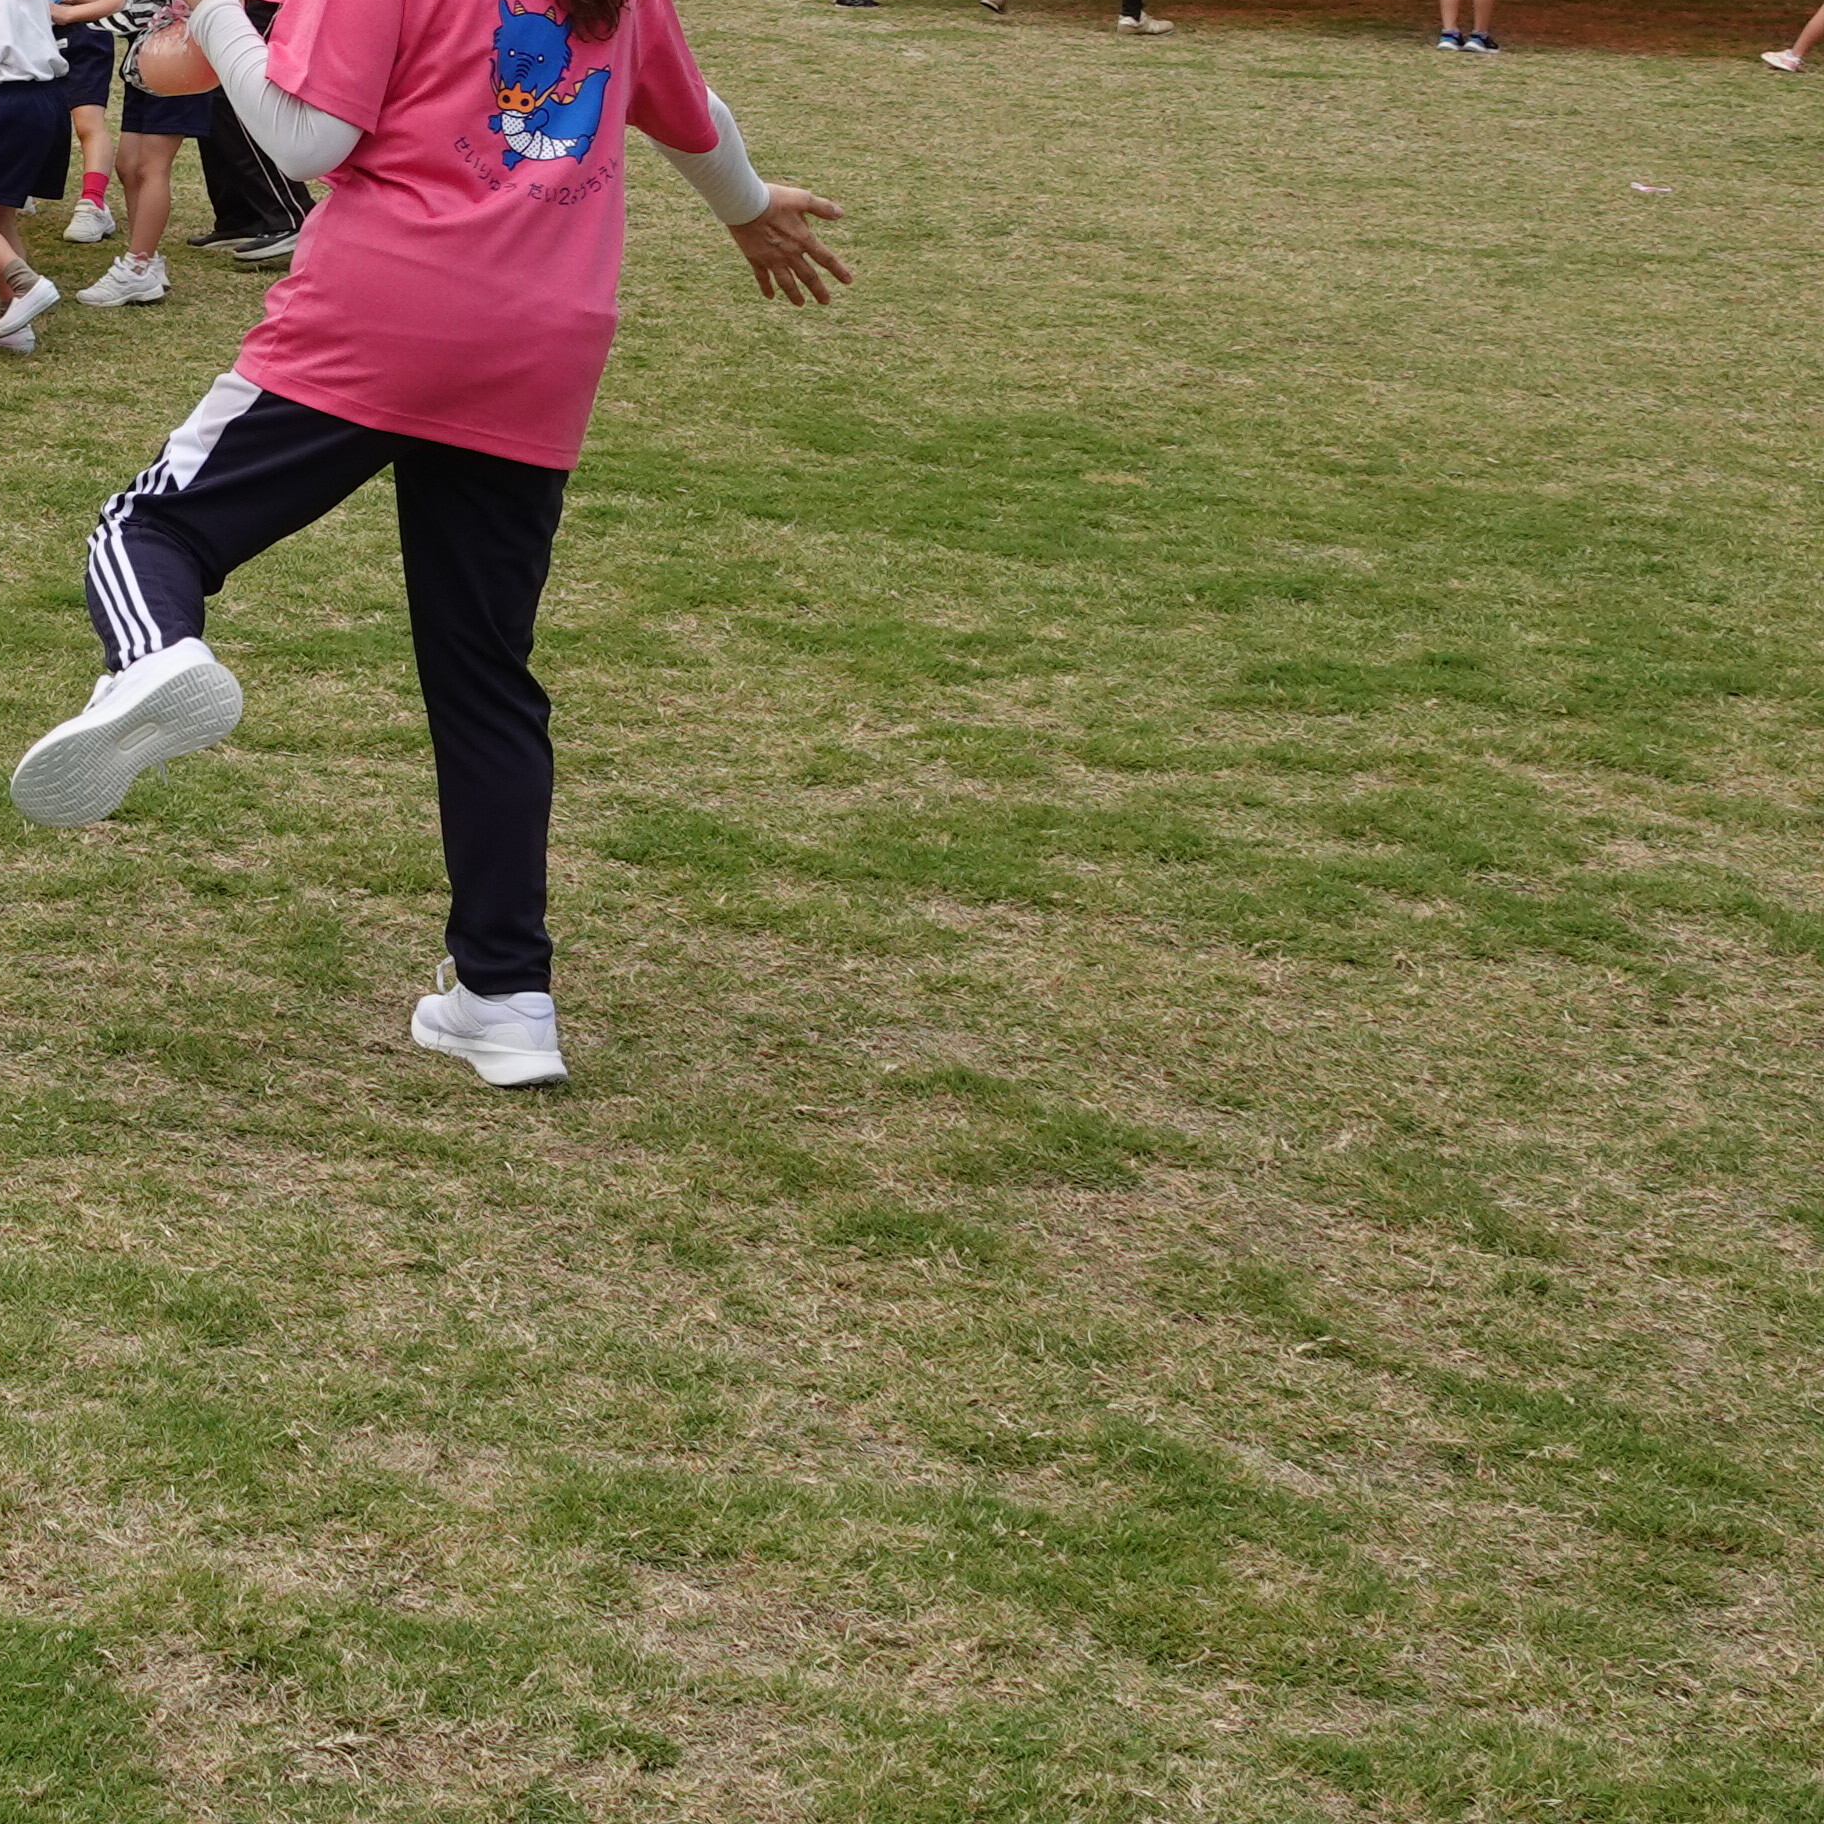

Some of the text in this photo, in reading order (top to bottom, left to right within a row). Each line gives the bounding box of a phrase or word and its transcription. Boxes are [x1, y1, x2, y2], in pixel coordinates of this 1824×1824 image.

[453, 135, 517, 192] せいりゅう
